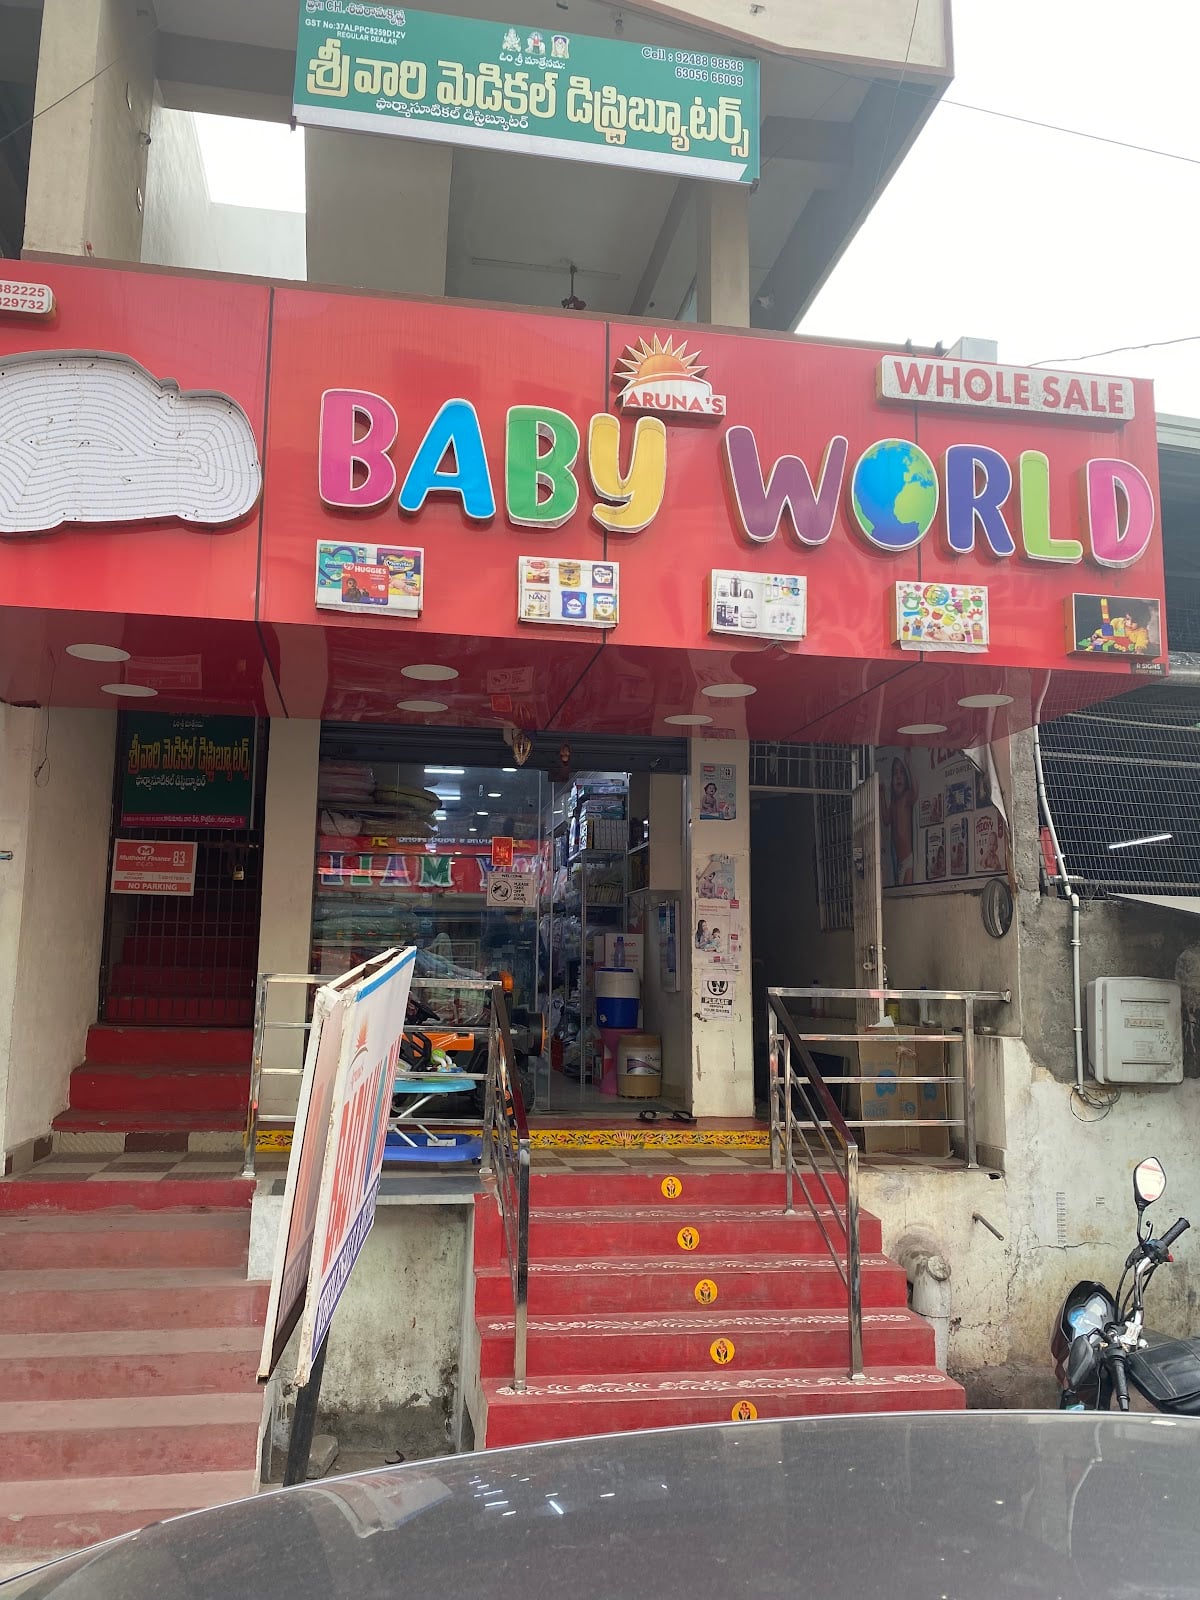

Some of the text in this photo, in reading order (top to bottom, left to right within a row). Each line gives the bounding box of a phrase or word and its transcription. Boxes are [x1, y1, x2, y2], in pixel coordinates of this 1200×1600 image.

[305, 19, 321, 27] GST
[337, 30, 398, 45] REGULAR DEALAR
[642, 48, 666, 61] Cell
[675, 52, 708, 67] 92488
[711, 57, 744, 72] 98536
[675, 67, 744, 86] 63056 66099
[436, 60, 559, 118] మెడికల్
[894, 360, 1125, 415] WHOLE SALE
[625, 391, 724, 414] ARUNA'S
[319, 388, 1155, 569] BABY WORLD
[354, 566, 386, 575] HUGGIES
[142, 882, 178, 890] PARKING
